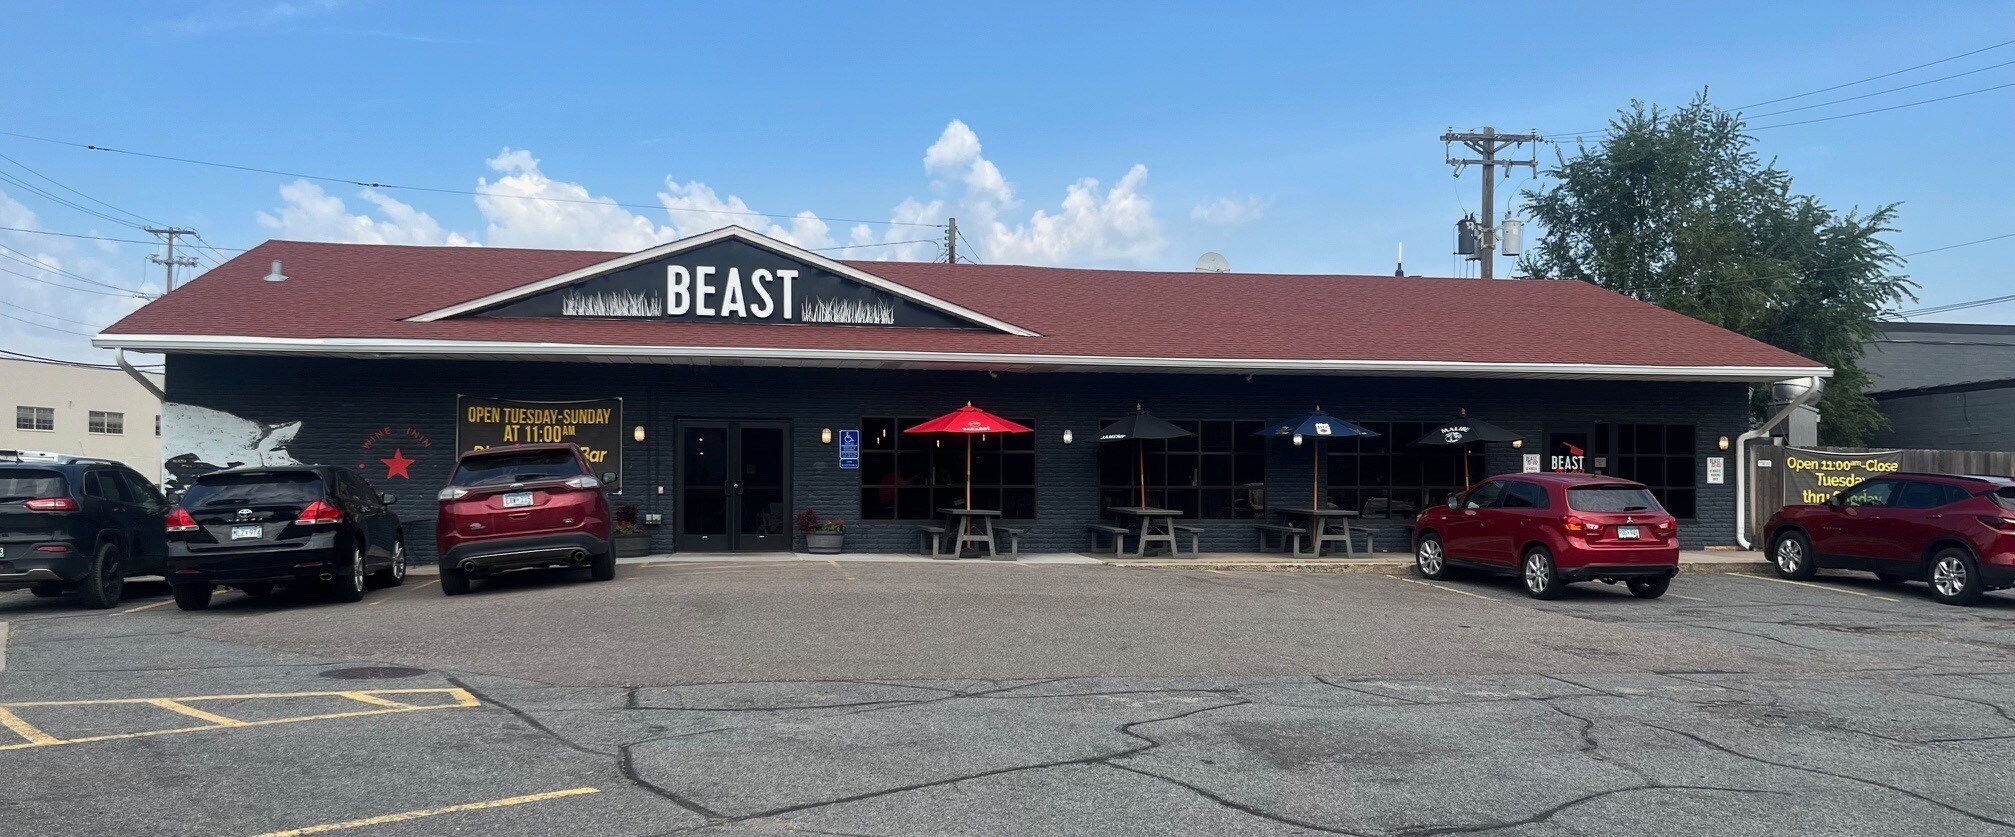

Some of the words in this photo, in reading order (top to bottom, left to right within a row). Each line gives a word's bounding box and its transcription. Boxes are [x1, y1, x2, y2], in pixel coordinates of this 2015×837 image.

[667, 265, 799, 319] BEAST
[468, 406, 500, 423] OPEN
[503, 408, 611, 424] TUESDAY-SUNDAY
[504, 425, 520, 442] AT
[1552, 455, 1585, 470] BEAST
[1787, 456, 1819, 472] Open
[1815, 472, 1865, 487] Tuesda
